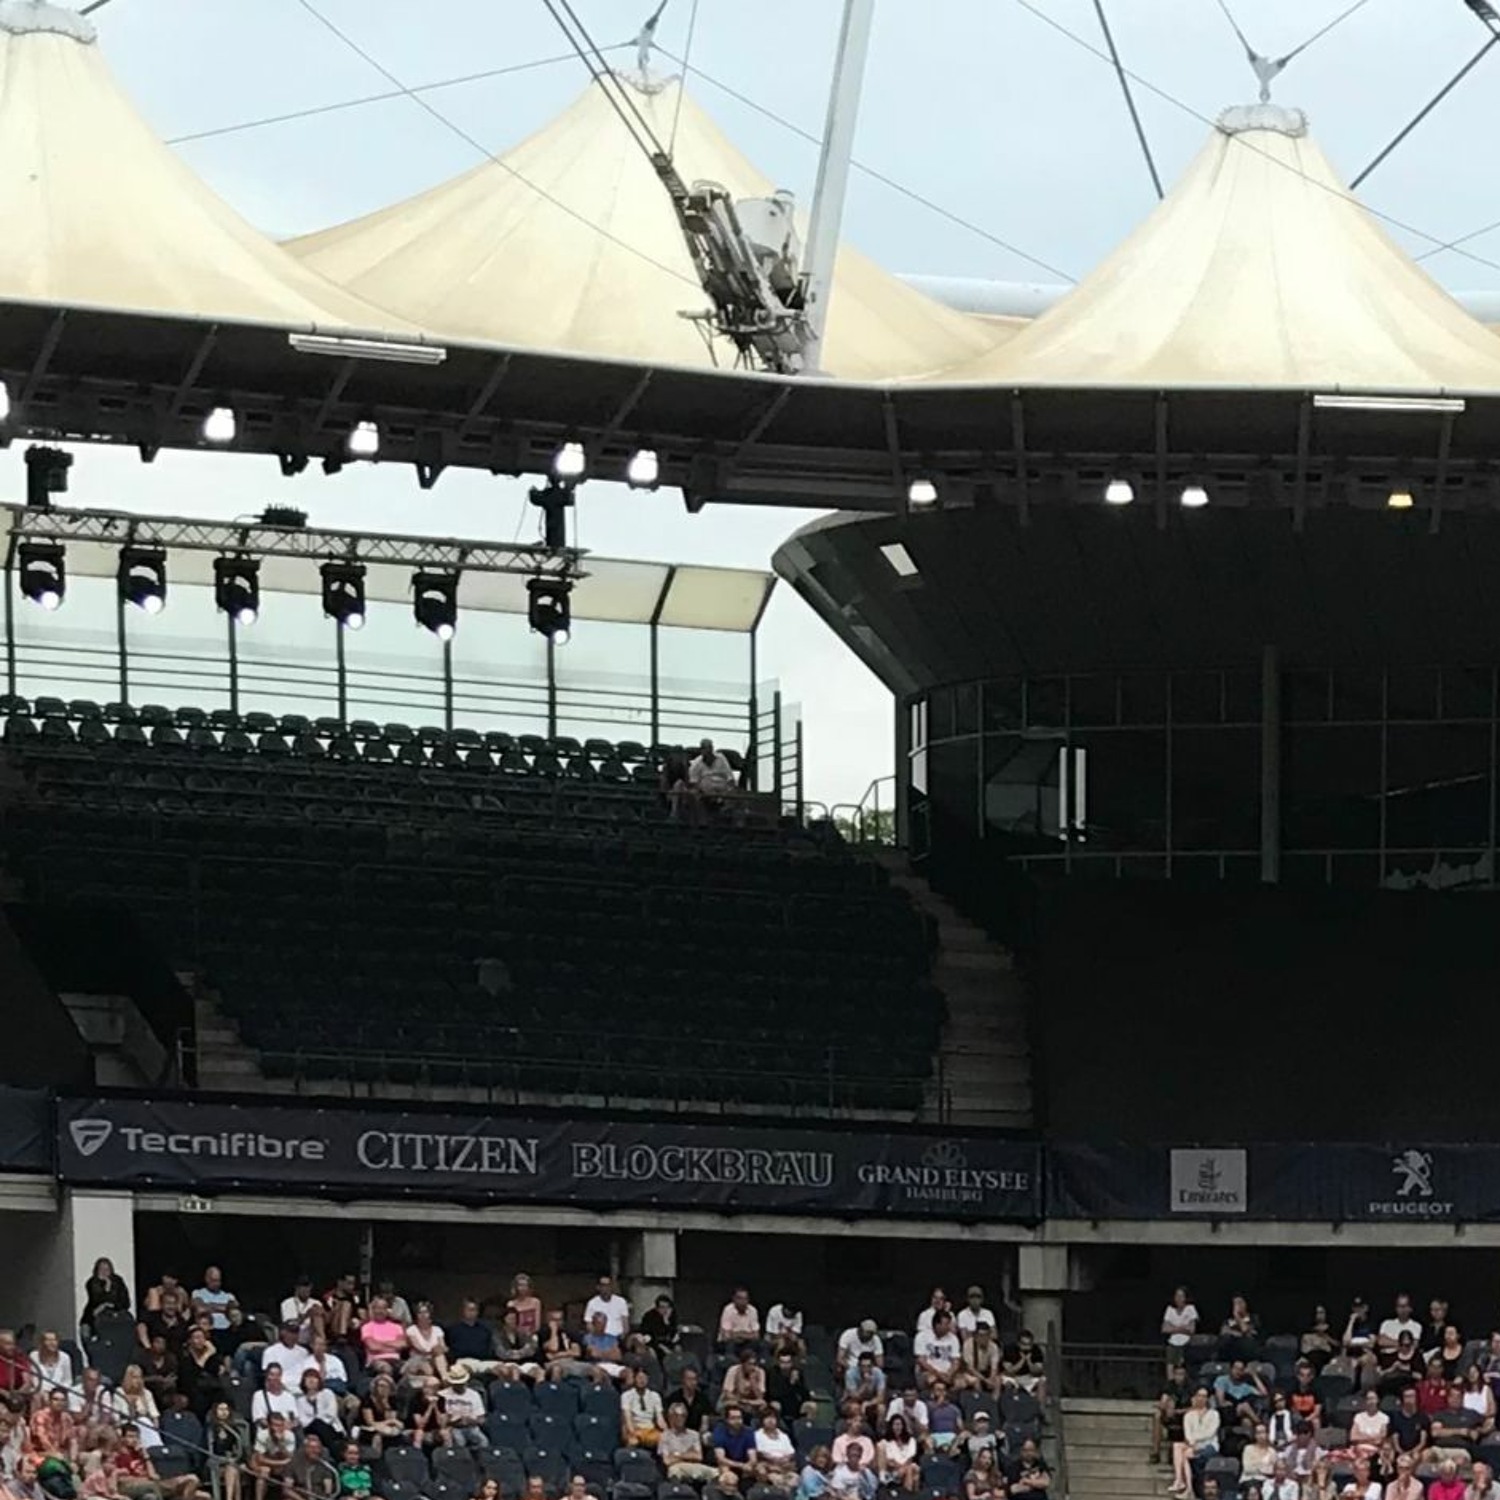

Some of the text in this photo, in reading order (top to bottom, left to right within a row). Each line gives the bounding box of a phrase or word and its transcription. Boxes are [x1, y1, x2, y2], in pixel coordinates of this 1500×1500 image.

[119, 1127, 325, 1160] Tecnifibre
[356, 1129, 539, 1175] CITIZEN
[858, 1164, 940, 1186] GRAND
[905, 1187, 984, 1202] HAMBURG
[1179, 1188, 1239, 1204] Emirates
[1369, 1201, 1453, 1216] PEUGEOT
